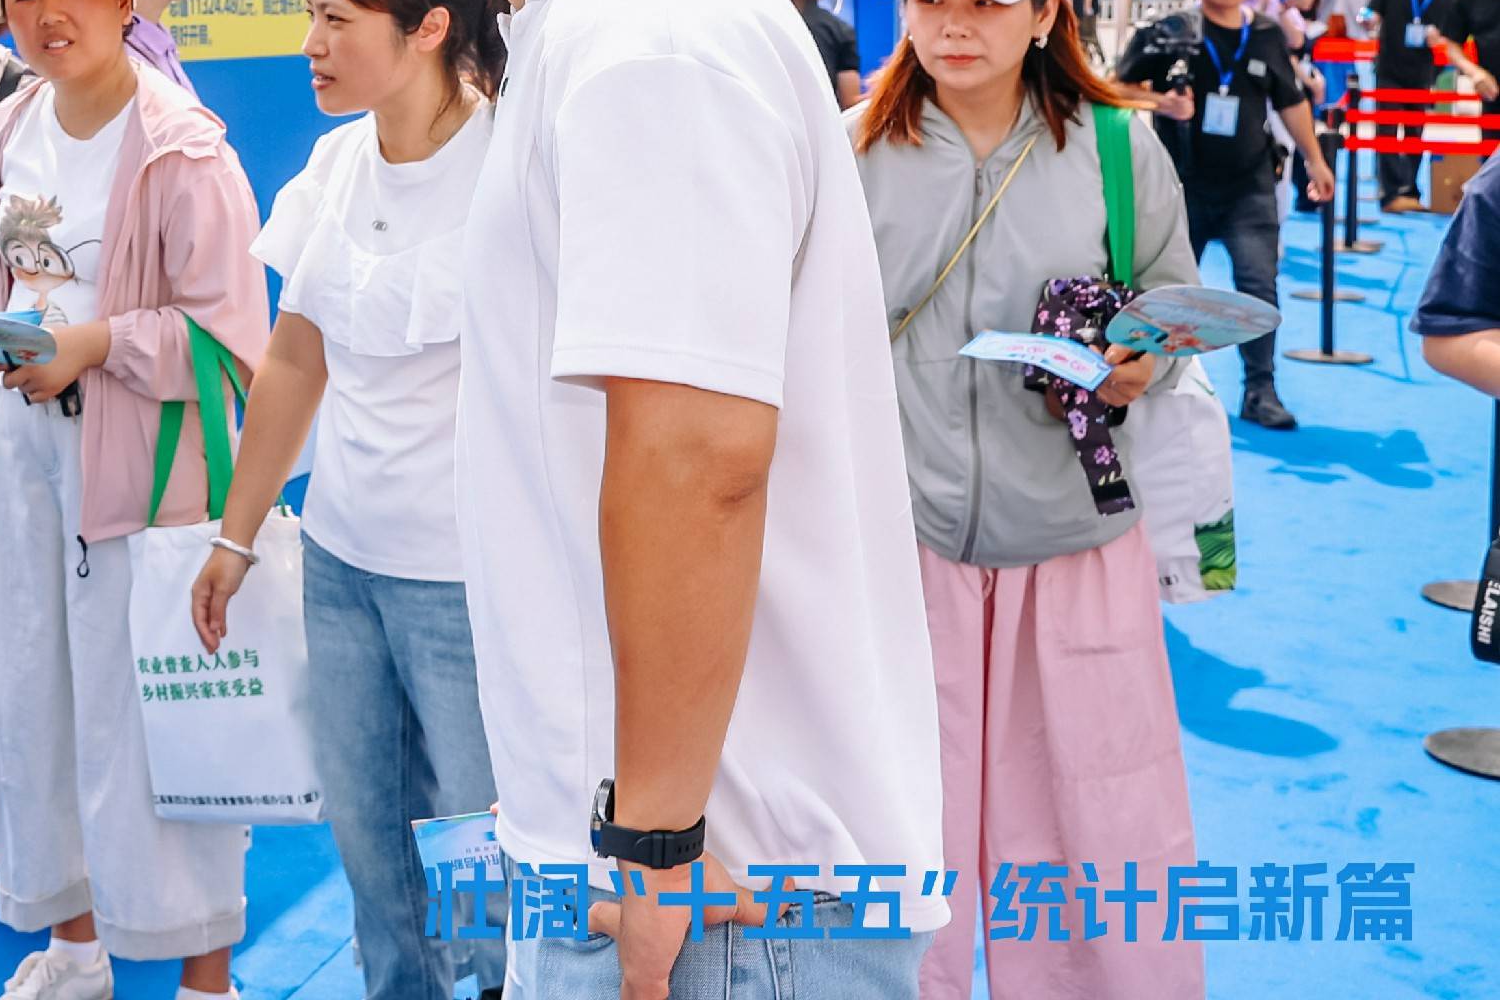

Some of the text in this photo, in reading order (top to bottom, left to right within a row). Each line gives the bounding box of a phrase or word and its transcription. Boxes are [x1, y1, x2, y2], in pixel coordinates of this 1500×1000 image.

[137, 648, 260, 675] 农业普查人人参与
[141, 677, 264, 702] 乡村振兴家家受益
